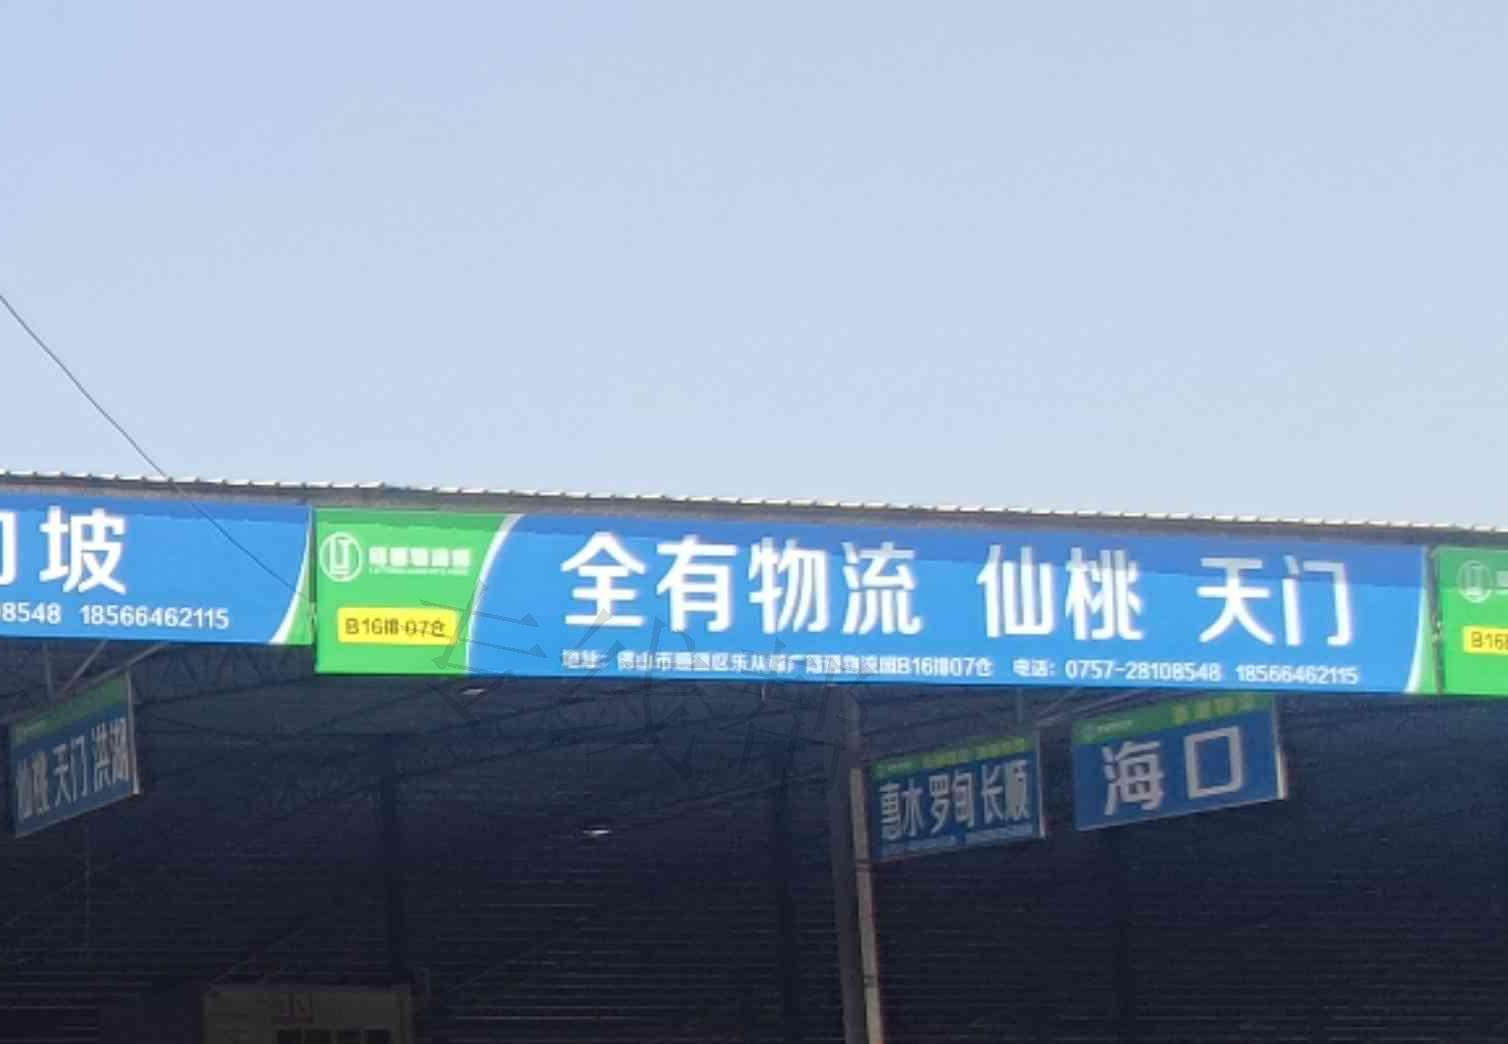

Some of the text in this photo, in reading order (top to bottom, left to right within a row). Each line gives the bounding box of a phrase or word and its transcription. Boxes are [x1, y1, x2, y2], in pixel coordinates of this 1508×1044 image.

[560, 531, 923, 635] 全有物流
[977, 545, 1144, 641] 仙桃
[1196, 555, 1353, 648] 天门
[80, 604, 230, 630] 18566462115
[1470, 631, 1508, 650] B16
[1236, 664, 1360, 686] 18566462115
[1101, 725, 1244, 817] 海口
